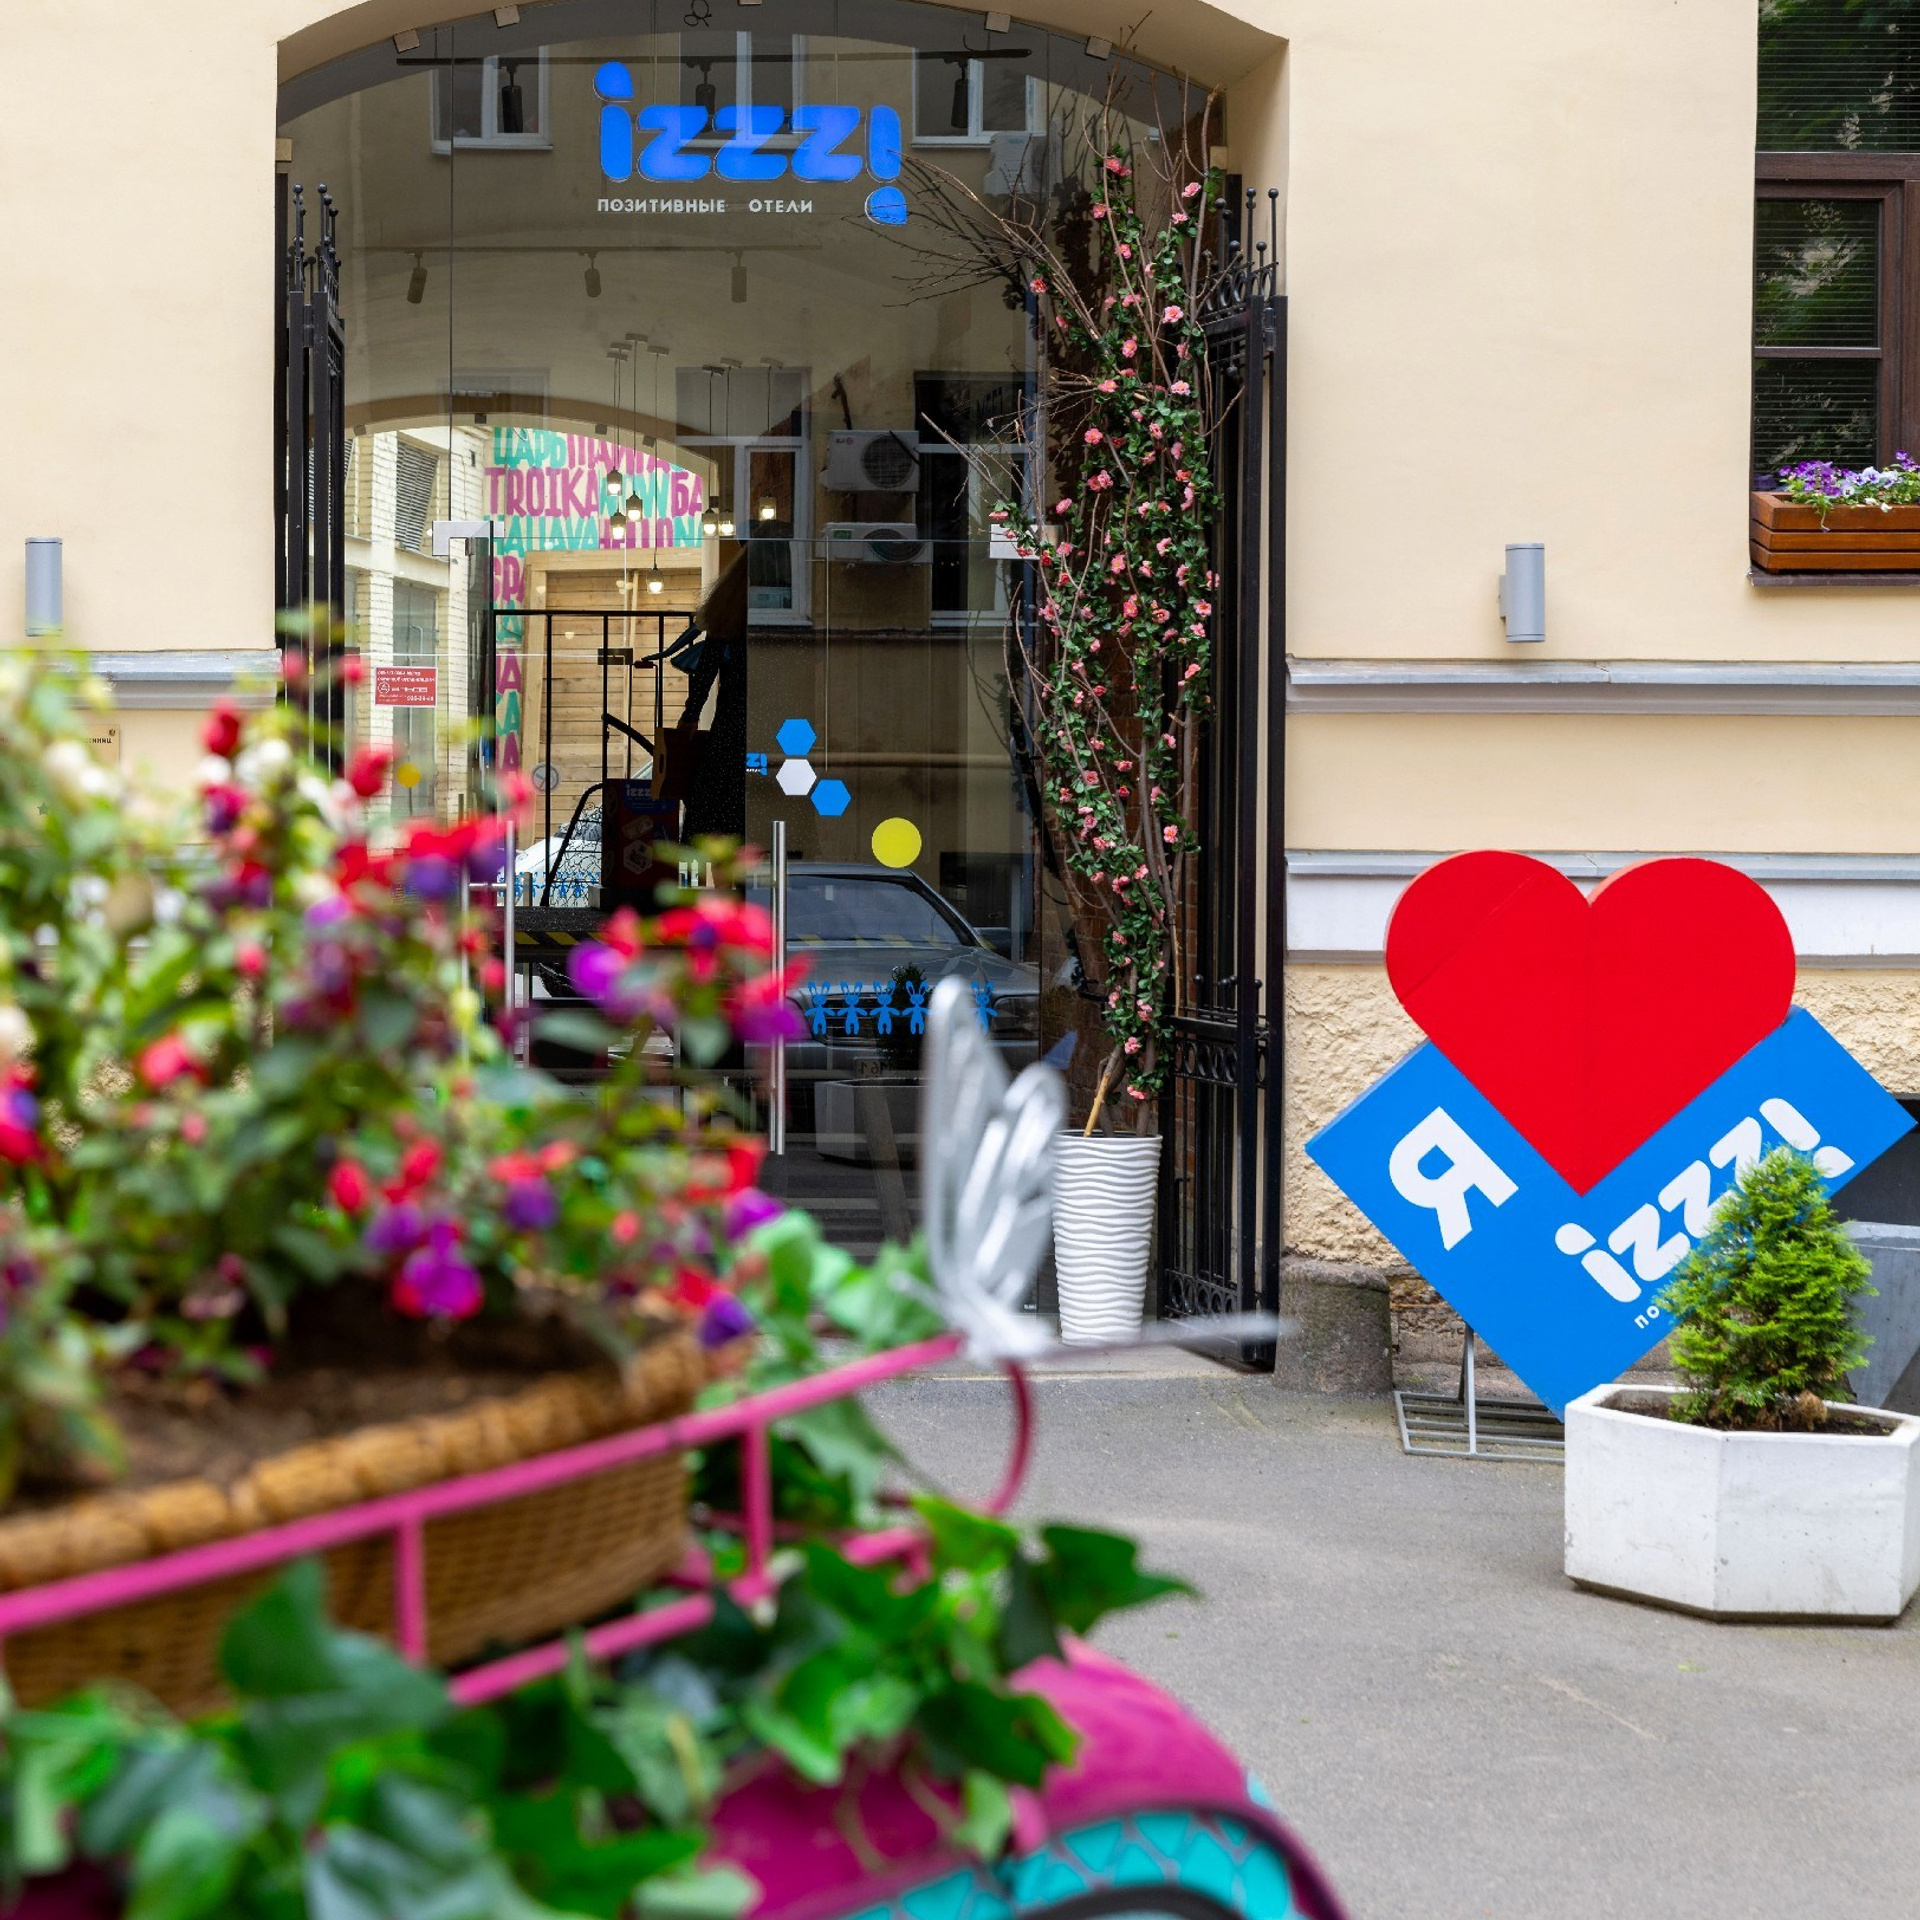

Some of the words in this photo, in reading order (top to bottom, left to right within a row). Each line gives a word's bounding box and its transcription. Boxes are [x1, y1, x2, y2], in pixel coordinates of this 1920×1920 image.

[597, 198, 726, 214] ПОЗИТИВНЫЕ
[748, 198, 814, 214] ОТЕЛИ
[484, 467, 599, 518] TROIKA
[1389, 1106, 1519, 1252] Я
